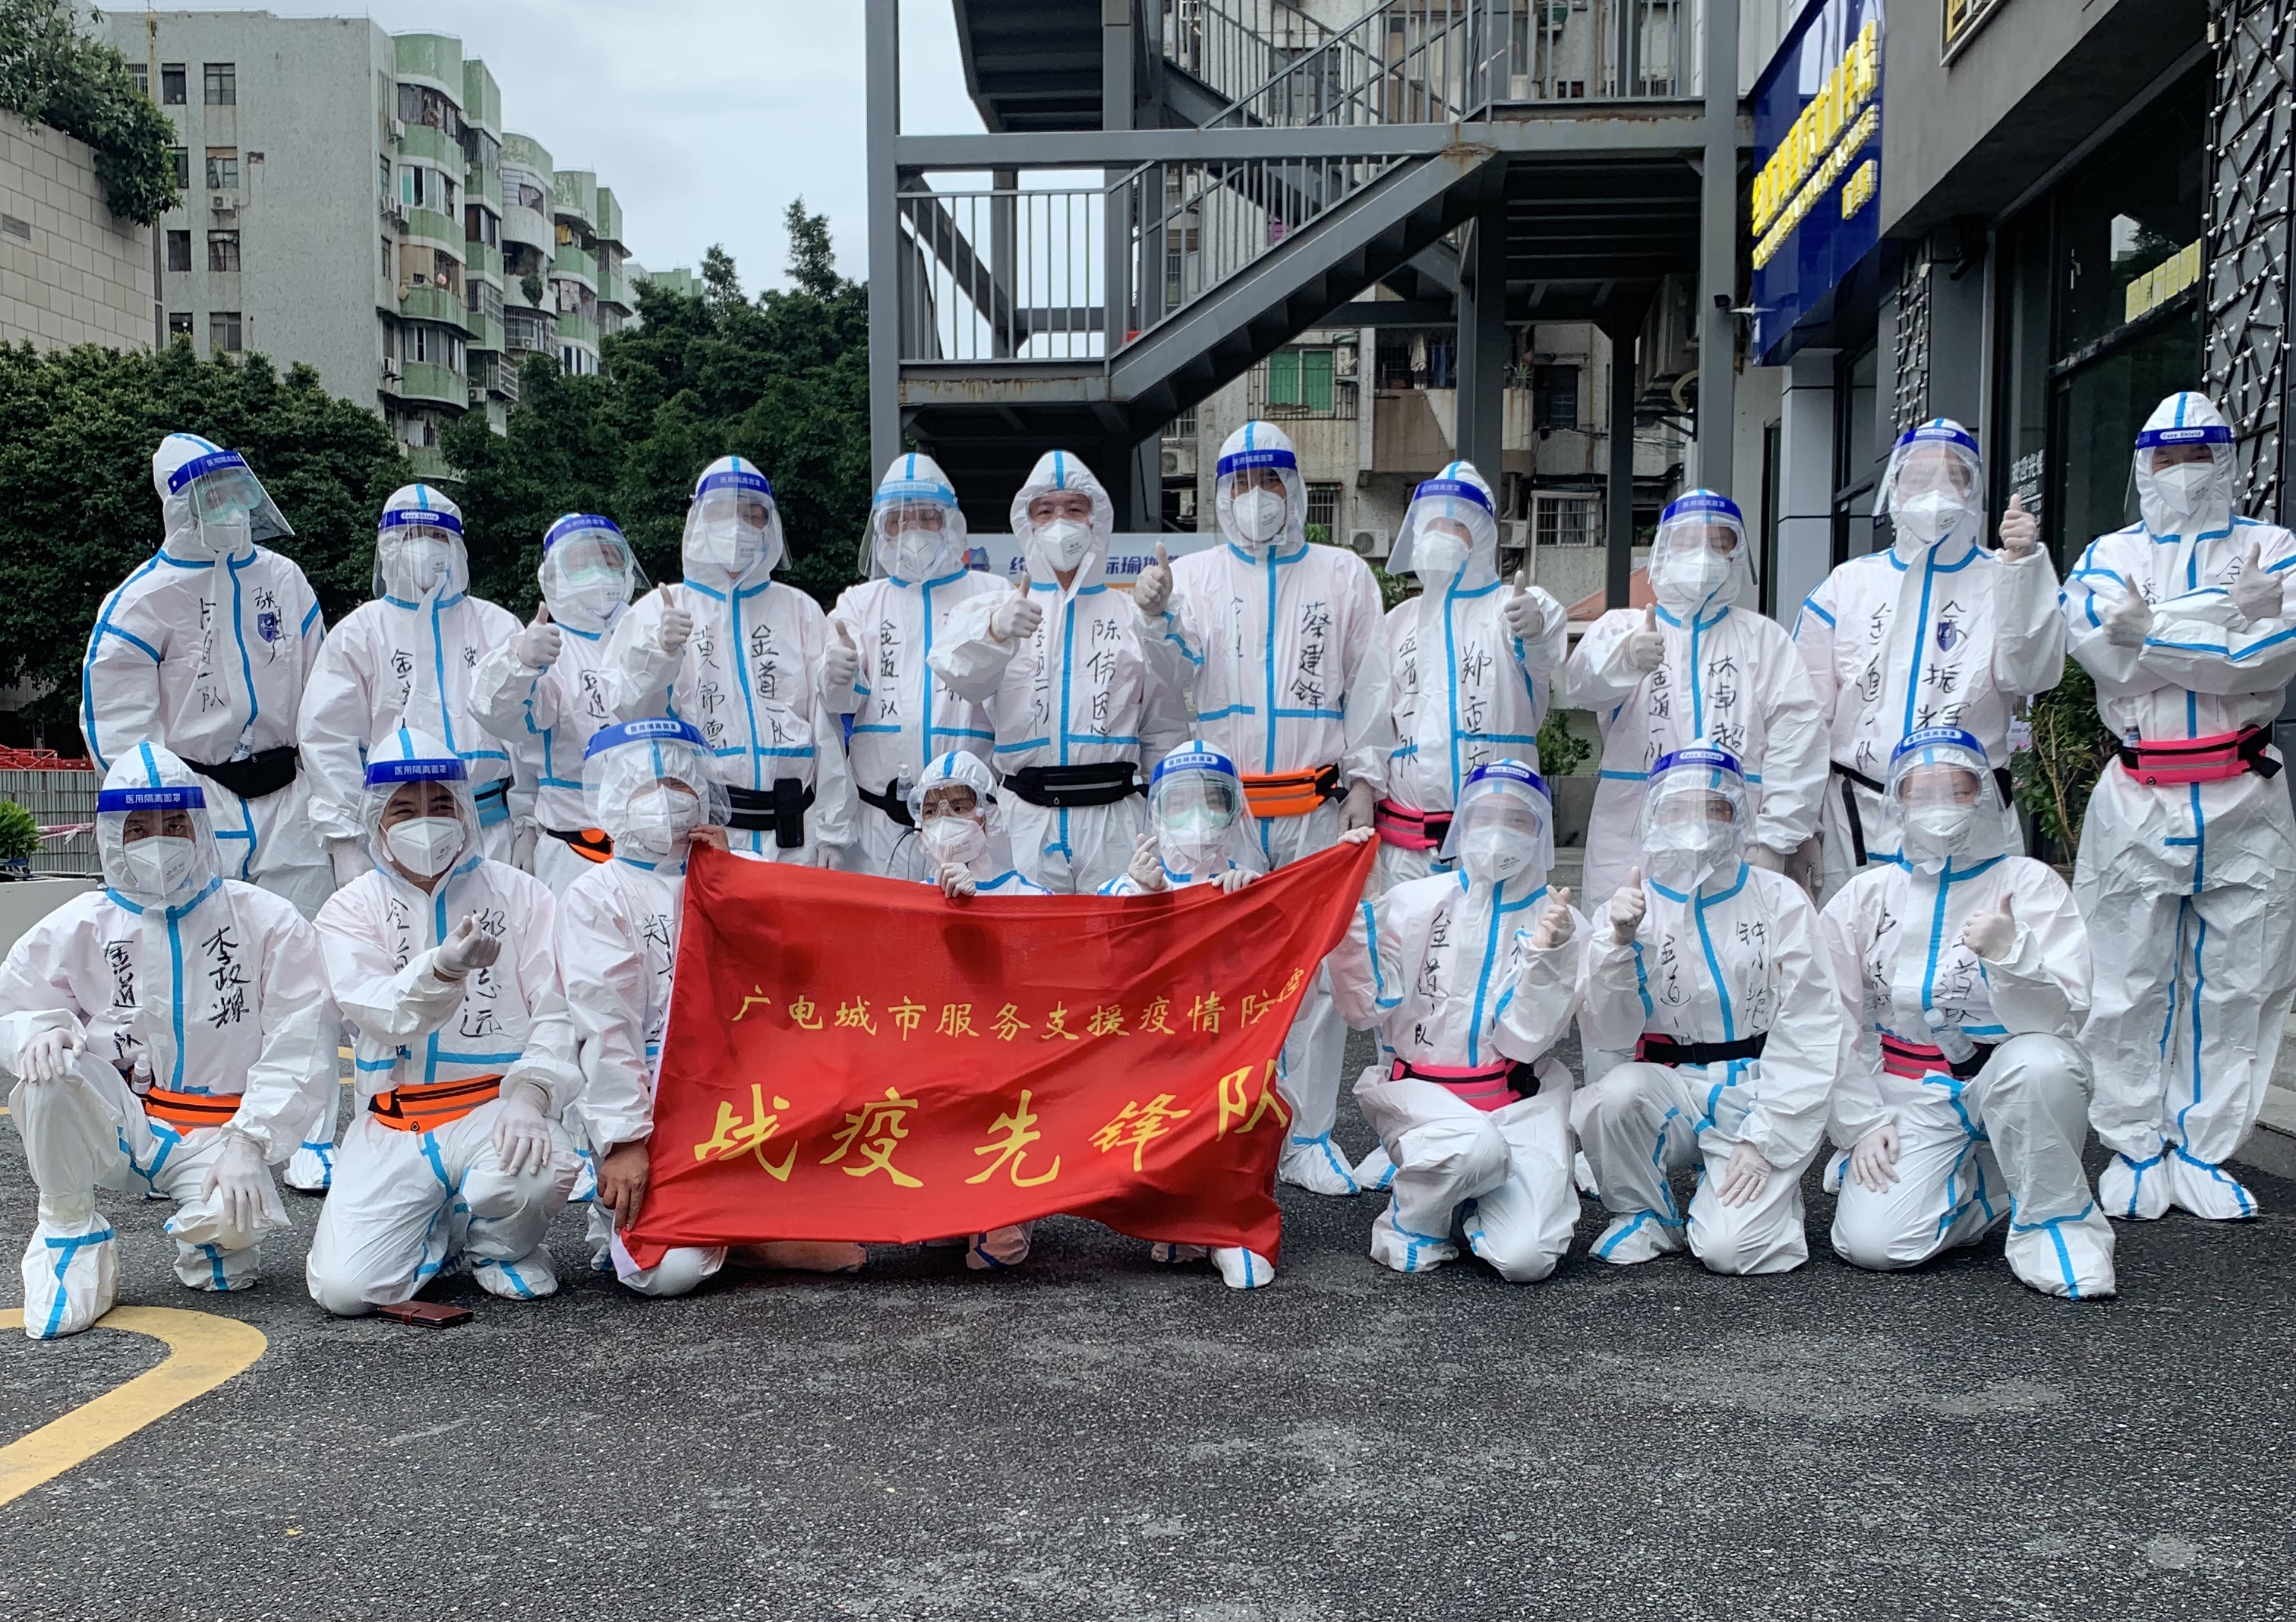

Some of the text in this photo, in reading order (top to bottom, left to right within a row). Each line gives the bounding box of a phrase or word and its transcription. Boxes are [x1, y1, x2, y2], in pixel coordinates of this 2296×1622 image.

[751, 623, 796, 743] 金道一队
[880, 619, 901, 719] 金道一队
[1708, 655, 1745, 760] 林卓超
[394, 765, 447, 775] 医用隔离面罩
[630, 722, 677, 731] 医用隔离面罩
[126, 793, 181, 804] 医用隔离面罩
[694, 1059, 1289, 1189] 战疫先锋队
